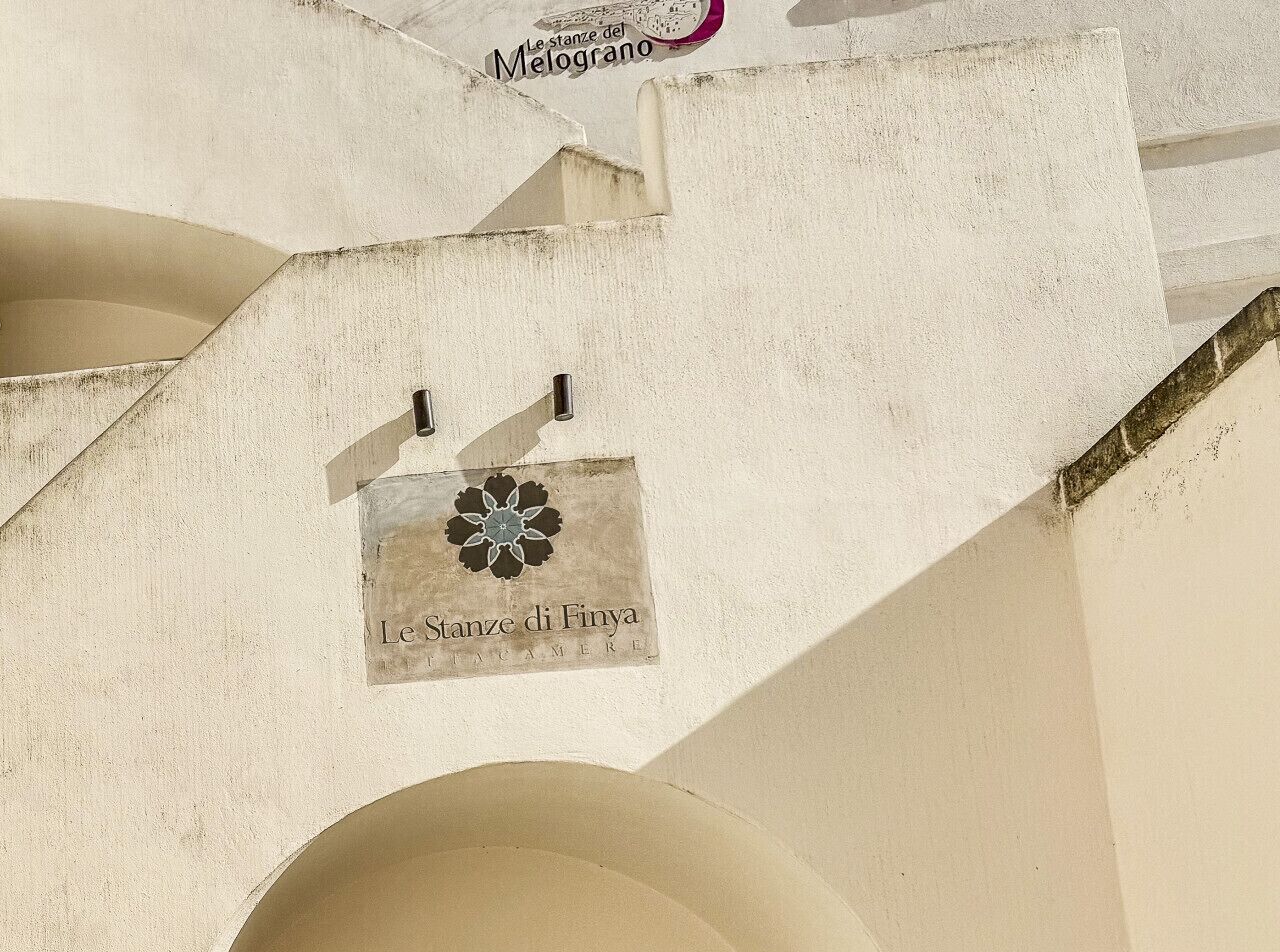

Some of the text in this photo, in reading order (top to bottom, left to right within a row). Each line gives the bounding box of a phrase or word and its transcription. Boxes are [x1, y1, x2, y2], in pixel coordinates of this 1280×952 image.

[526, 21, 625, 52] Le stanze del
[494, 39, 653, 80] Melograno
[381, 603, 640, 644] Le Stanze di Finya
